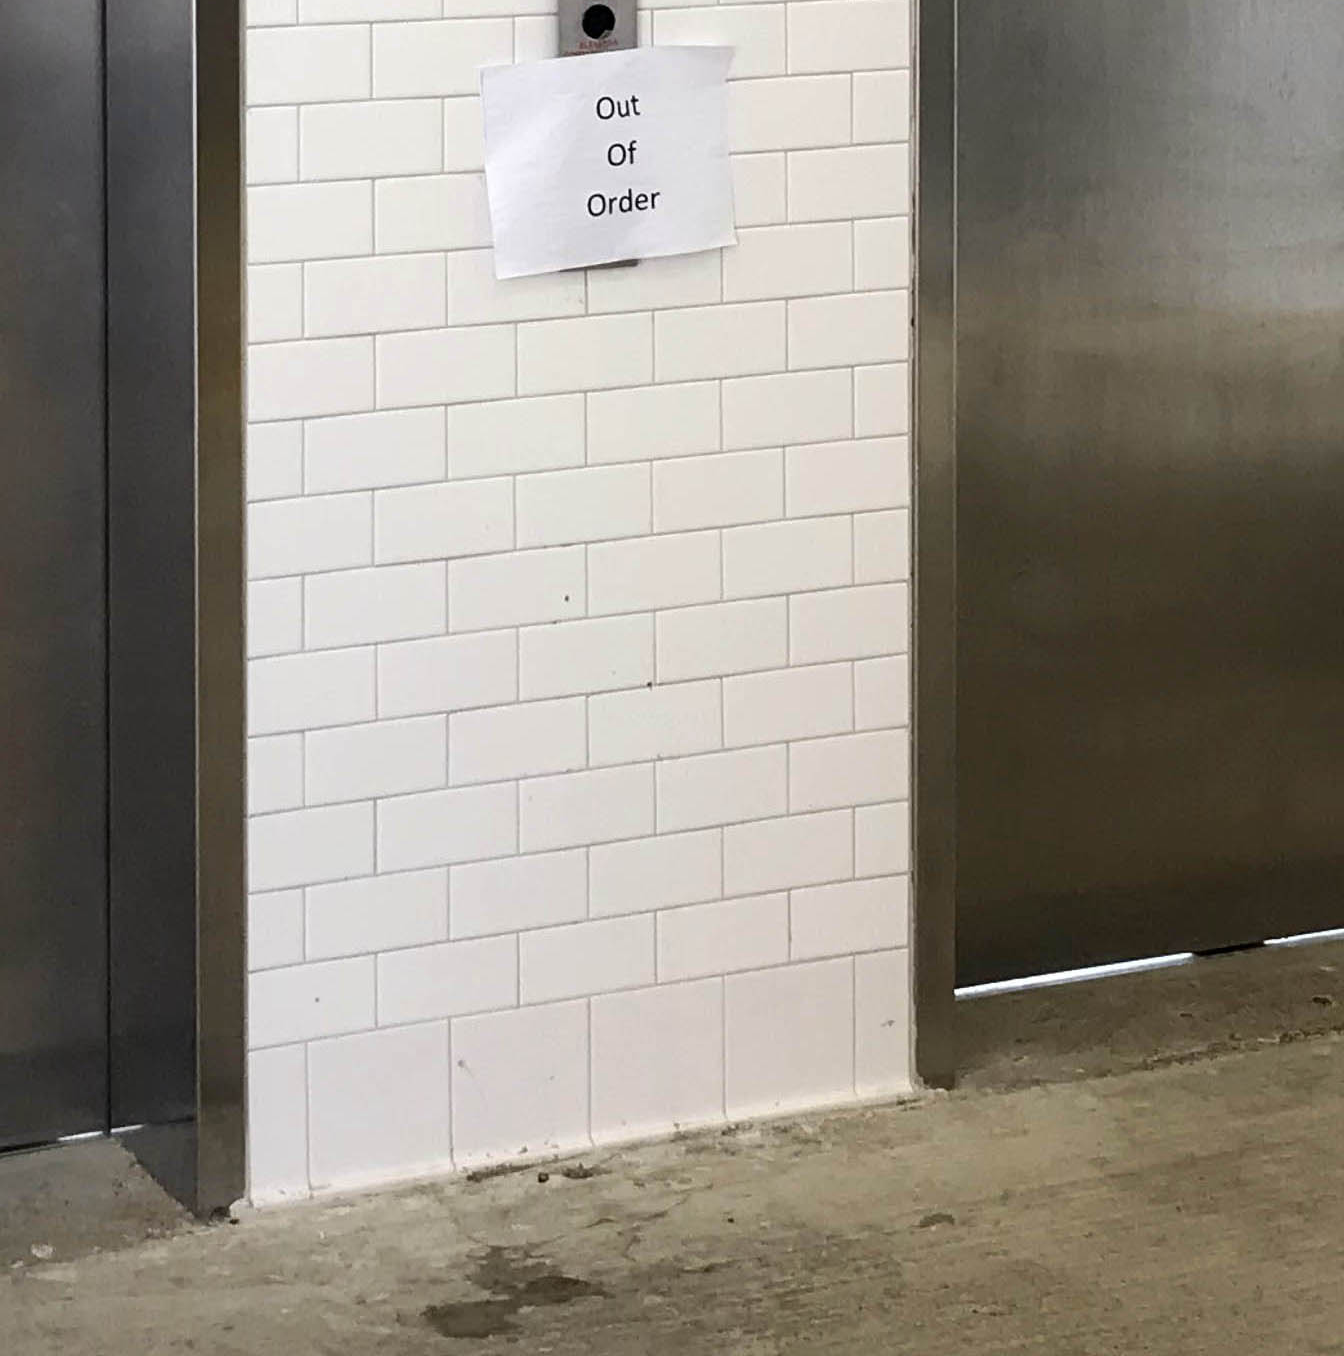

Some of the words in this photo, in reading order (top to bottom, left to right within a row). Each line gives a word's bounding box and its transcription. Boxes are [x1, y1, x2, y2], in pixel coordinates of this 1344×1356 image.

[596, 95, 640, 120] Out
[607, 140, 637, 166] Of
[587, 189, 660, 217] Order
